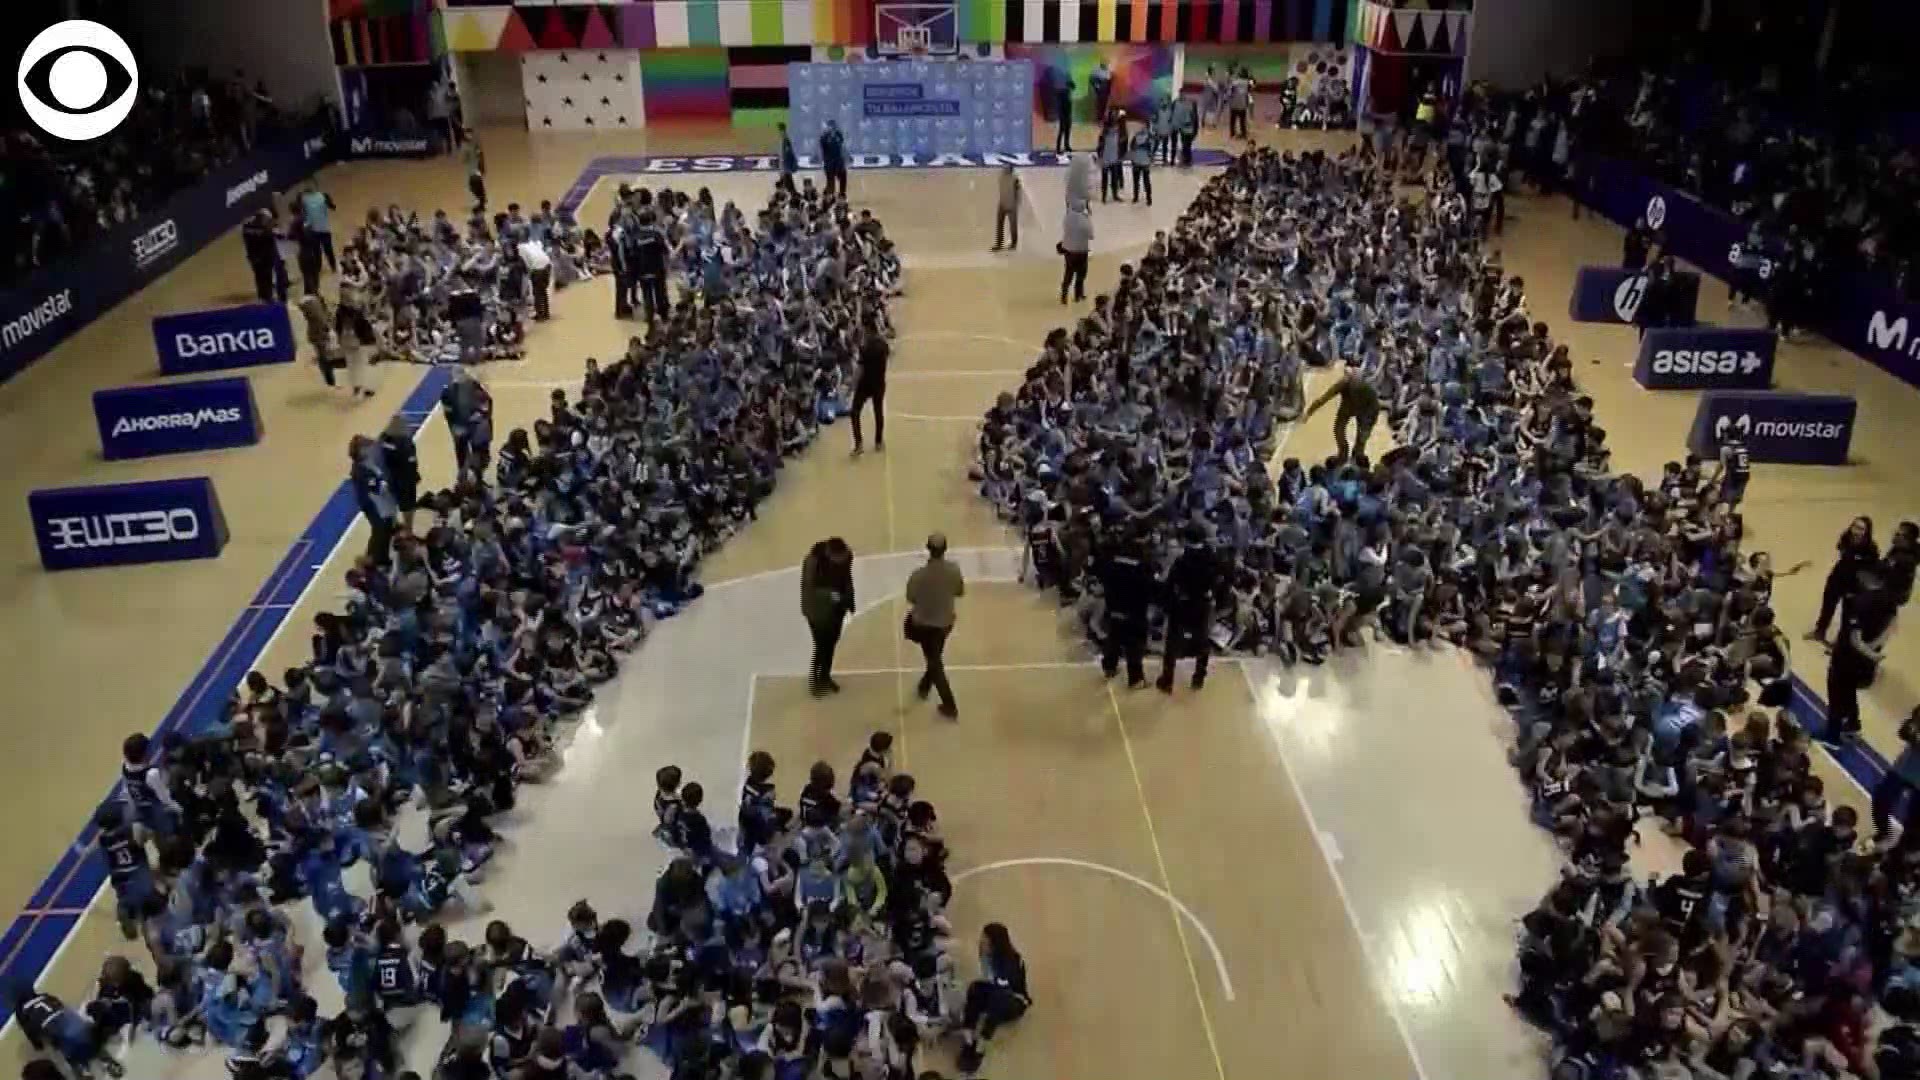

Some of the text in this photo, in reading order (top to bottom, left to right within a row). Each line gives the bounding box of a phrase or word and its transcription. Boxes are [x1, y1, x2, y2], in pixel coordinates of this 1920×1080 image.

[1, 288, 73, 348] movistar
[175, 327, 276, 358] Bankia
[1754, 420, 1845, 440] movistar
